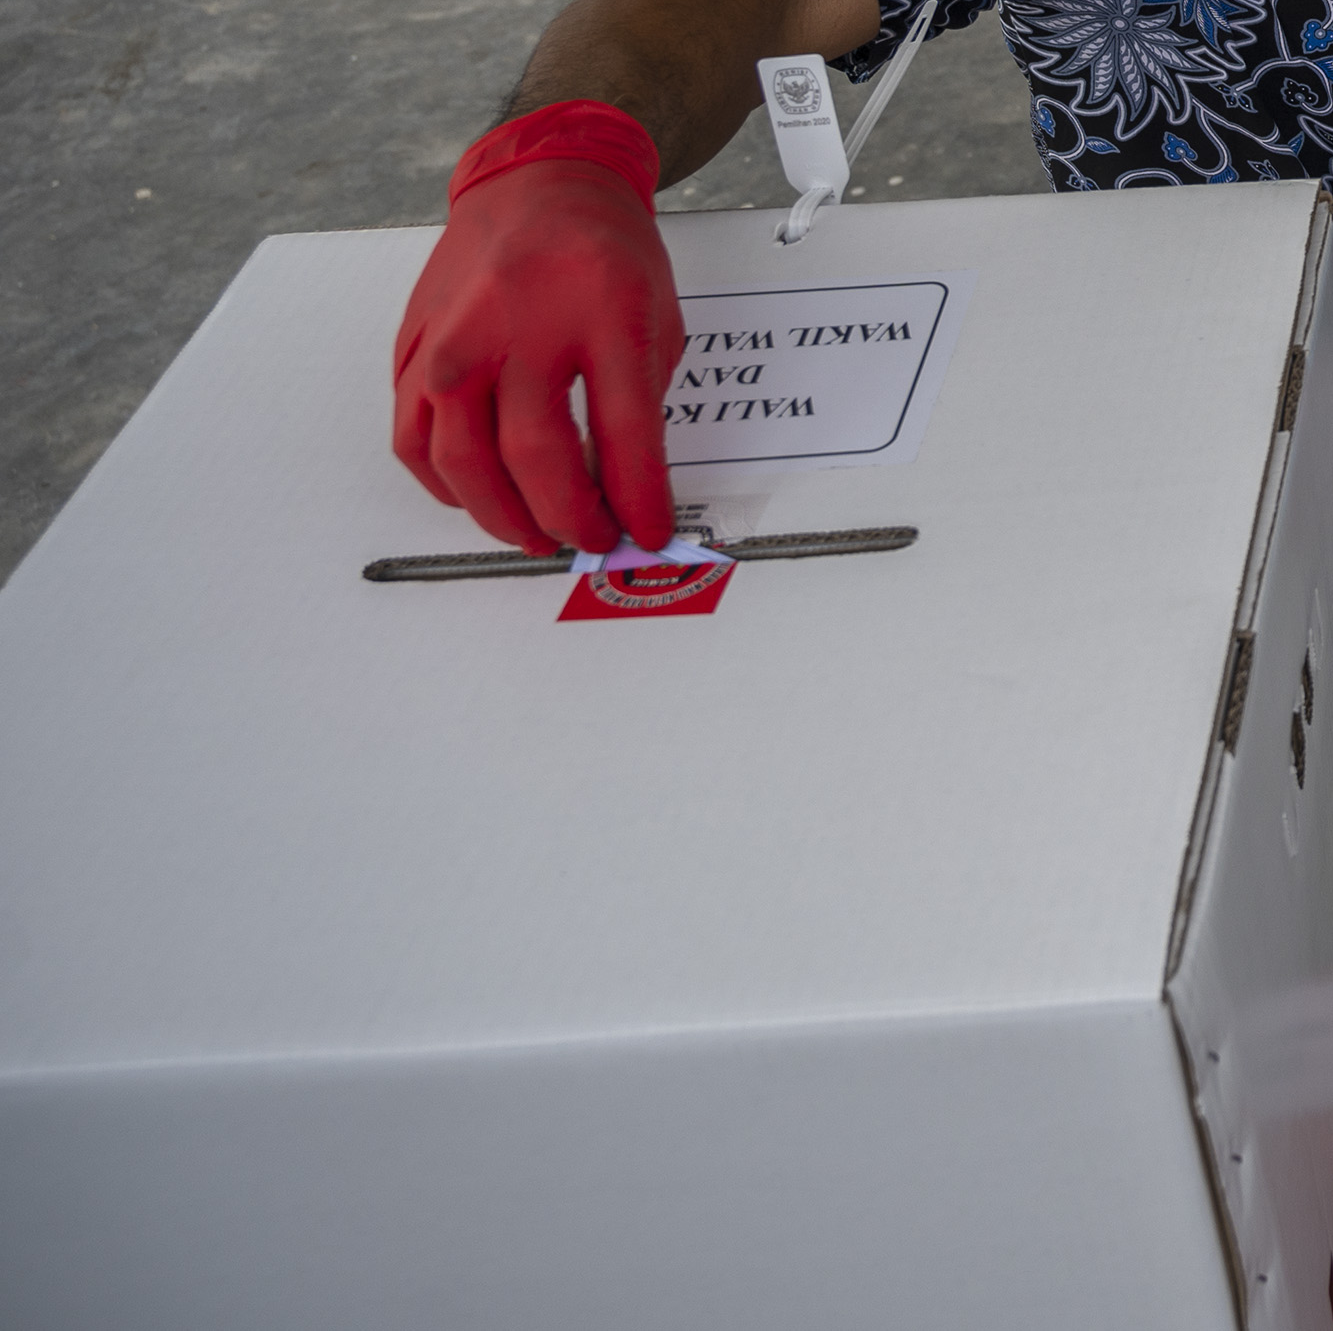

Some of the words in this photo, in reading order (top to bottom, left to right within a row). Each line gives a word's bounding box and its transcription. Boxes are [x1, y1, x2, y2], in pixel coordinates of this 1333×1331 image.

[813, 117, 831, 126] 2020
[788, 322, 912, 347] WAKIL
[678, 364, 767, 389] DAN
[713, 396, 815, 422] WALI
